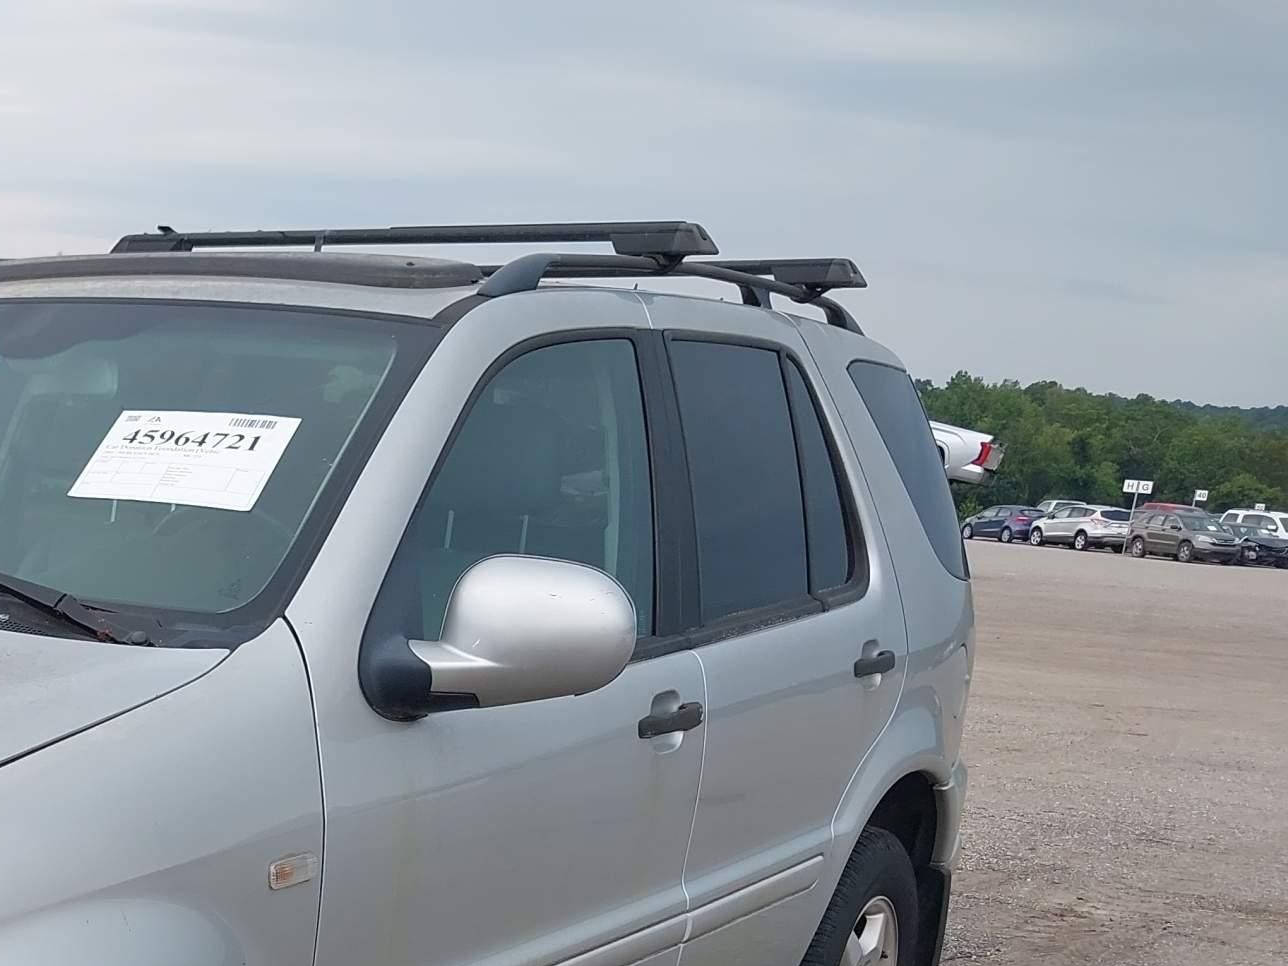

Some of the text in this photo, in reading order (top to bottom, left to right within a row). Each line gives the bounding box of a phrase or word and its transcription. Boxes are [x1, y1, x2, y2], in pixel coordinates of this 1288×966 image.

[122, 429, 263, 451] 45964721
[1126, 481, 1150, 491] H G
